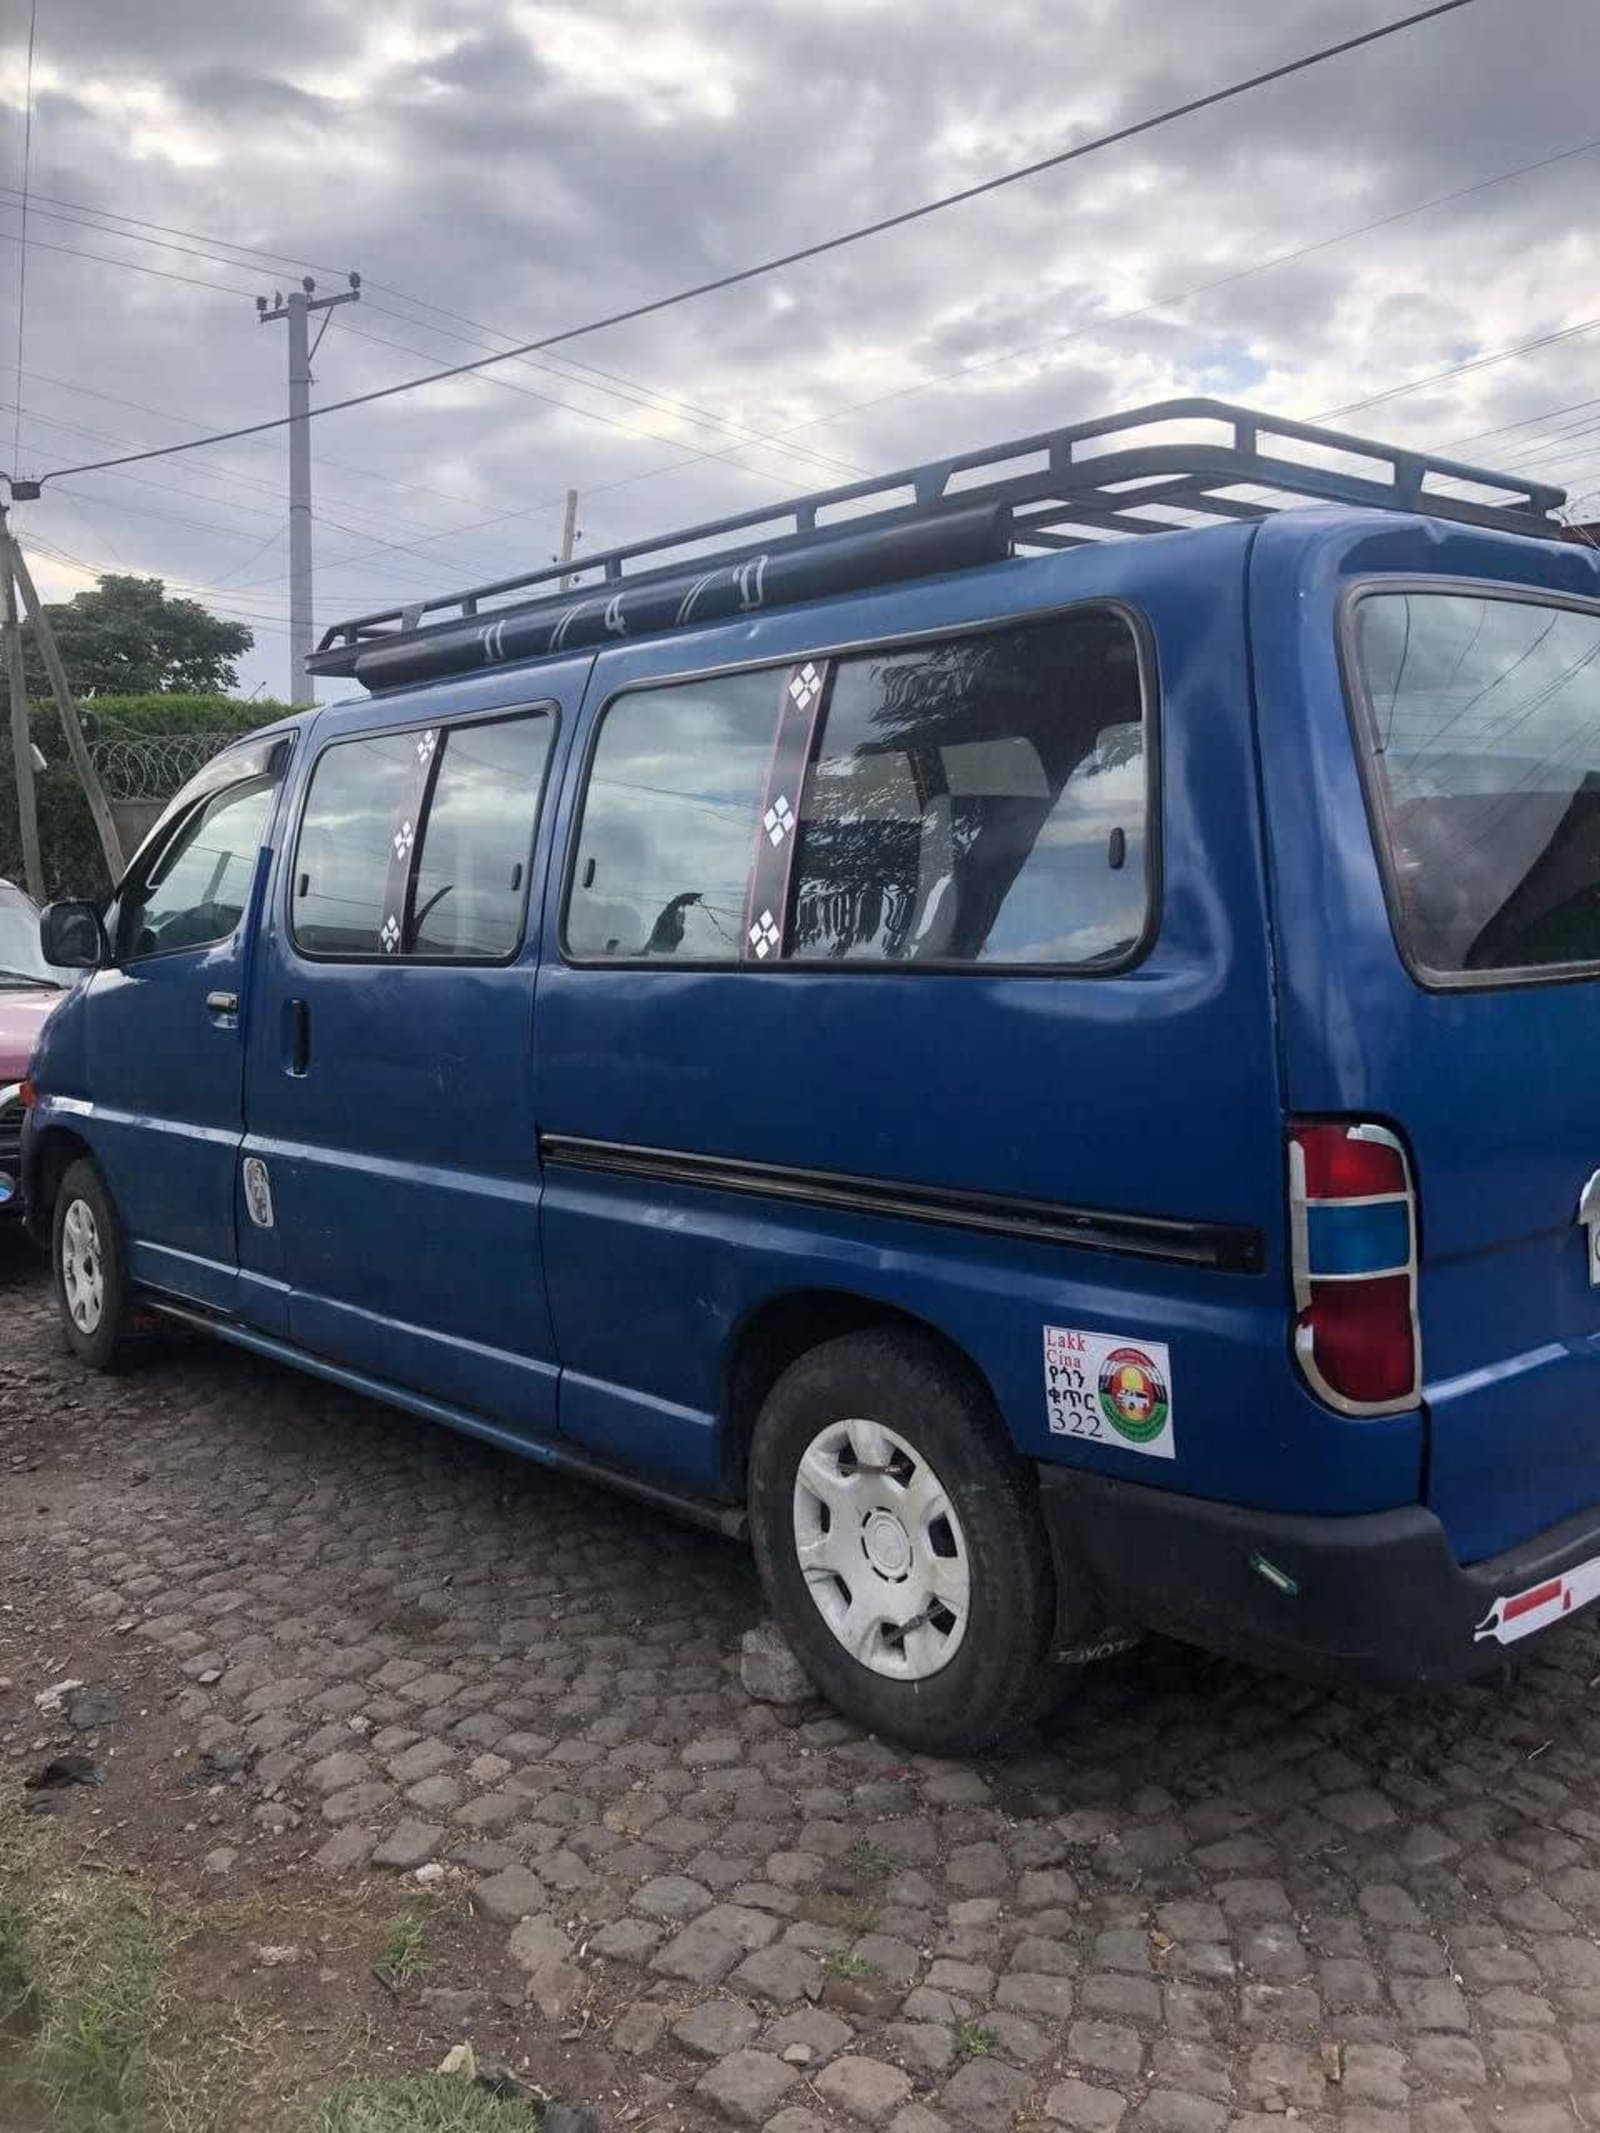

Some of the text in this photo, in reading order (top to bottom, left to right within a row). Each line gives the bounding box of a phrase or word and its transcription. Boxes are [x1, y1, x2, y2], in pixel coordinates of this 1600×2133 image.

[1047, 1328, 1085, 1352] Lakk
[1047, 1349, 1081, 1369] Cina
[1052, 1408, 1102, 1438] 322
